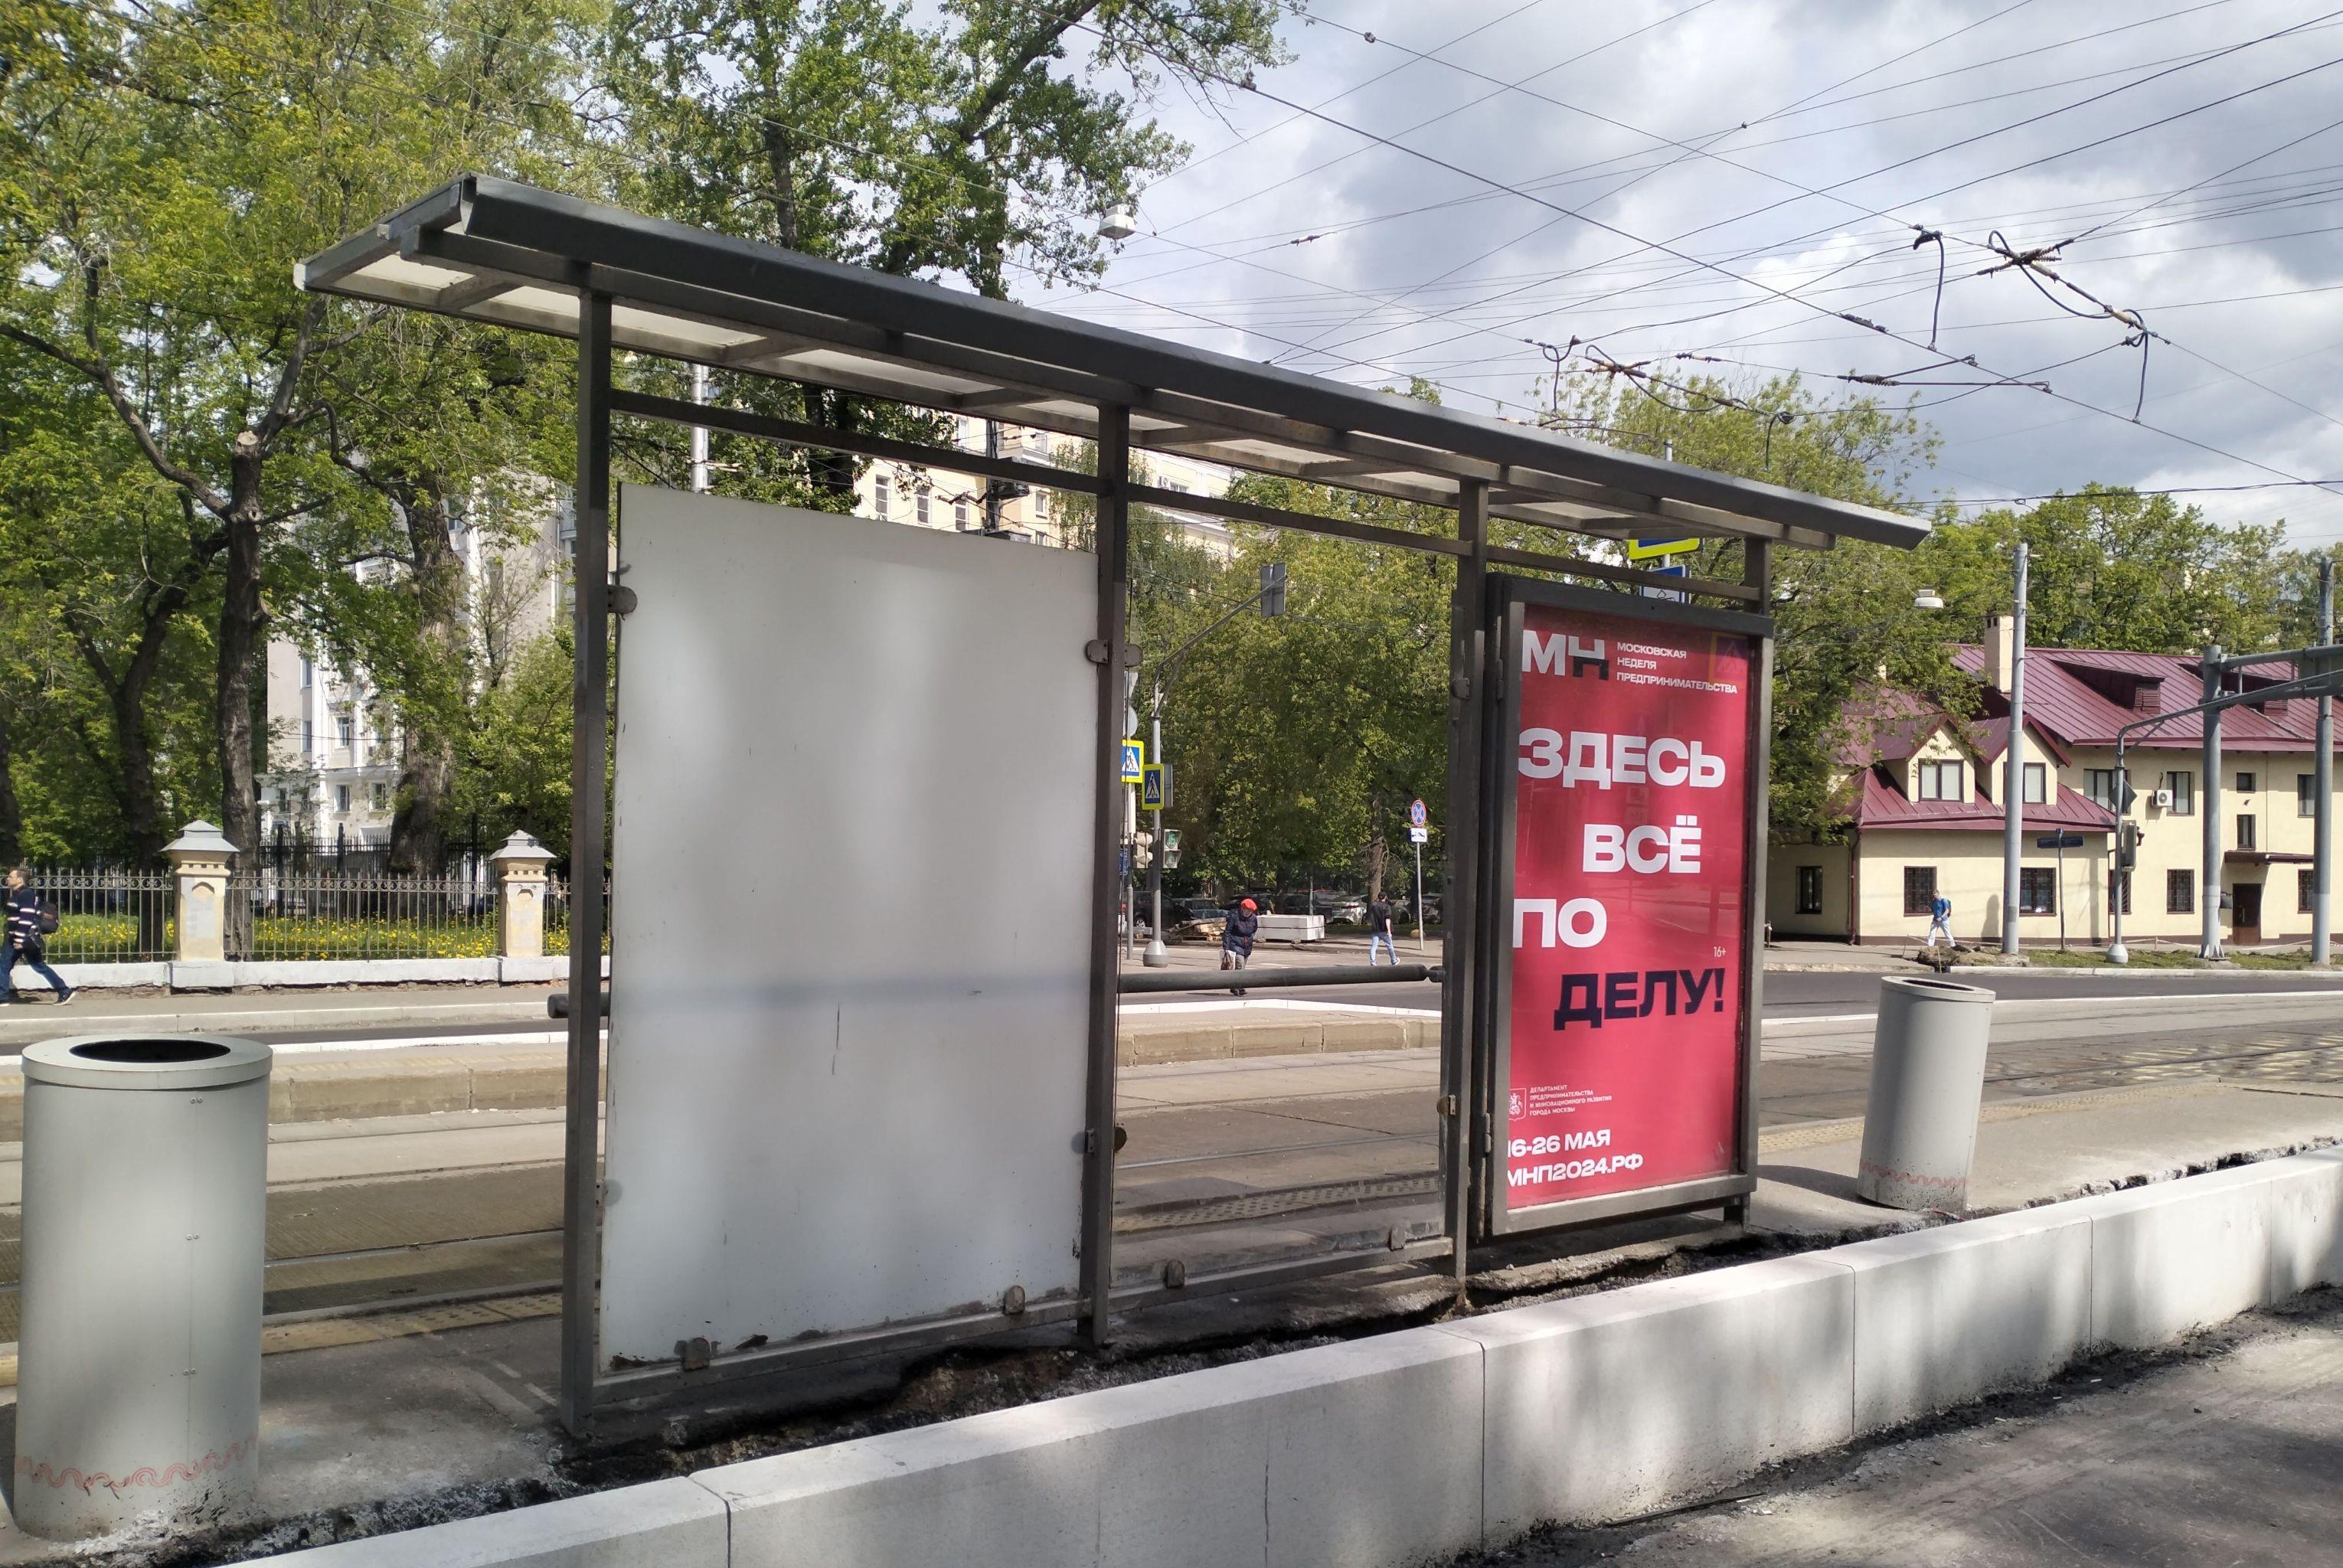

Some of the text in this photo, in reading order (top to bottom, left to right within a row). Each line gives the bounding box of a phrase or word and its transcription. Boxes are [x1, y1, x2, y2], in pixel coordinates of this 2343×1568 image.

[1617, 642, 1688, 659] МОСКОВСКАЯ
[1617, 656, 1657, 670] НЕДЕЛЯ
[1616, 671, 1738, 694] ПРЕДПРИНИМАТЕЛЬСТВА
[1518, 727, 1726, 790] ЗДЕСЬ
[1583, 815, 1701, 874] ВСЁ
[1512, 897, 1607, 949] ПО
[1713, 946, 1727, 958] 16+
[1554, 967, 1726, 1031] ДЕЛУ!
[1529, 1108, 1551, 1117] ГОРОДА
[1564, 1129, 1611, 1152] МАЯ
[1507, 1153, 1643, 1187] МНП2024.РФ
